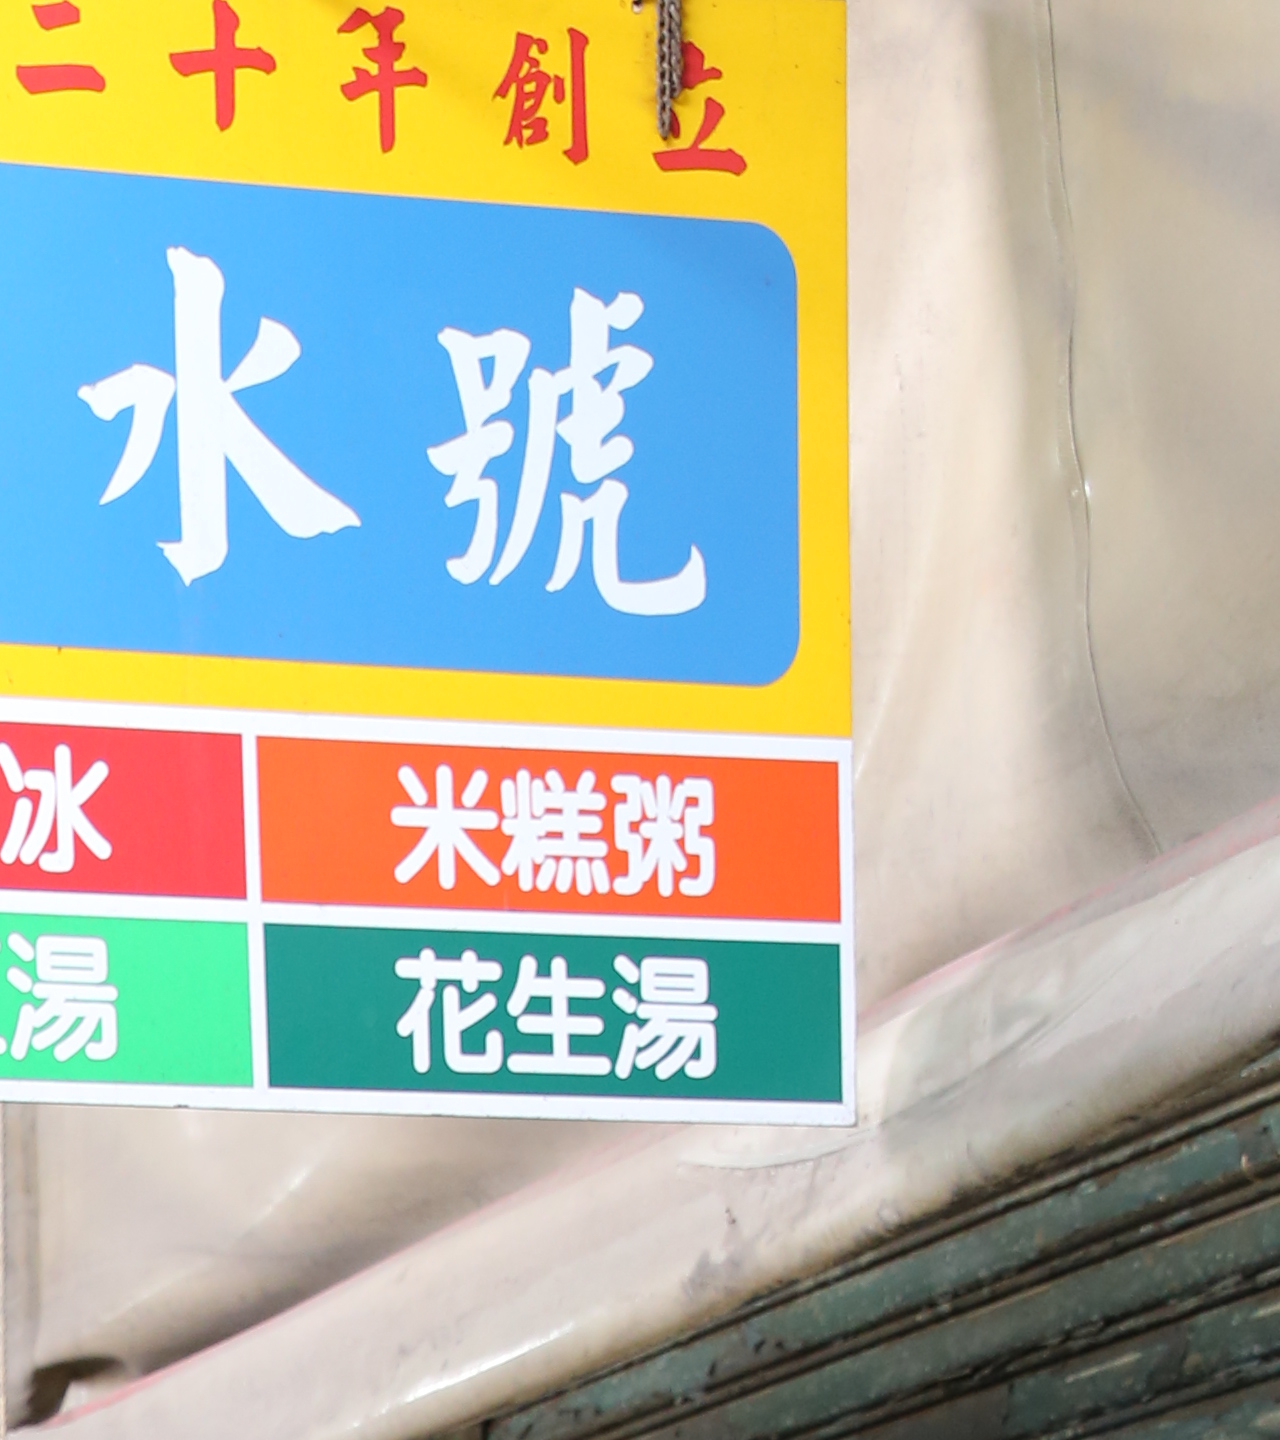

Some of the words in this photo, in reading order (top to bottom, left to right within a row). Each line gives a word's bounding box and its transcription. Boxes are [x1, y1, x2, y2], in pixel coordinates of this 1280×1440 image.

[391, 765, 715, 896] 米糕粥
[395, 949, 718, 1079] 花生湯
